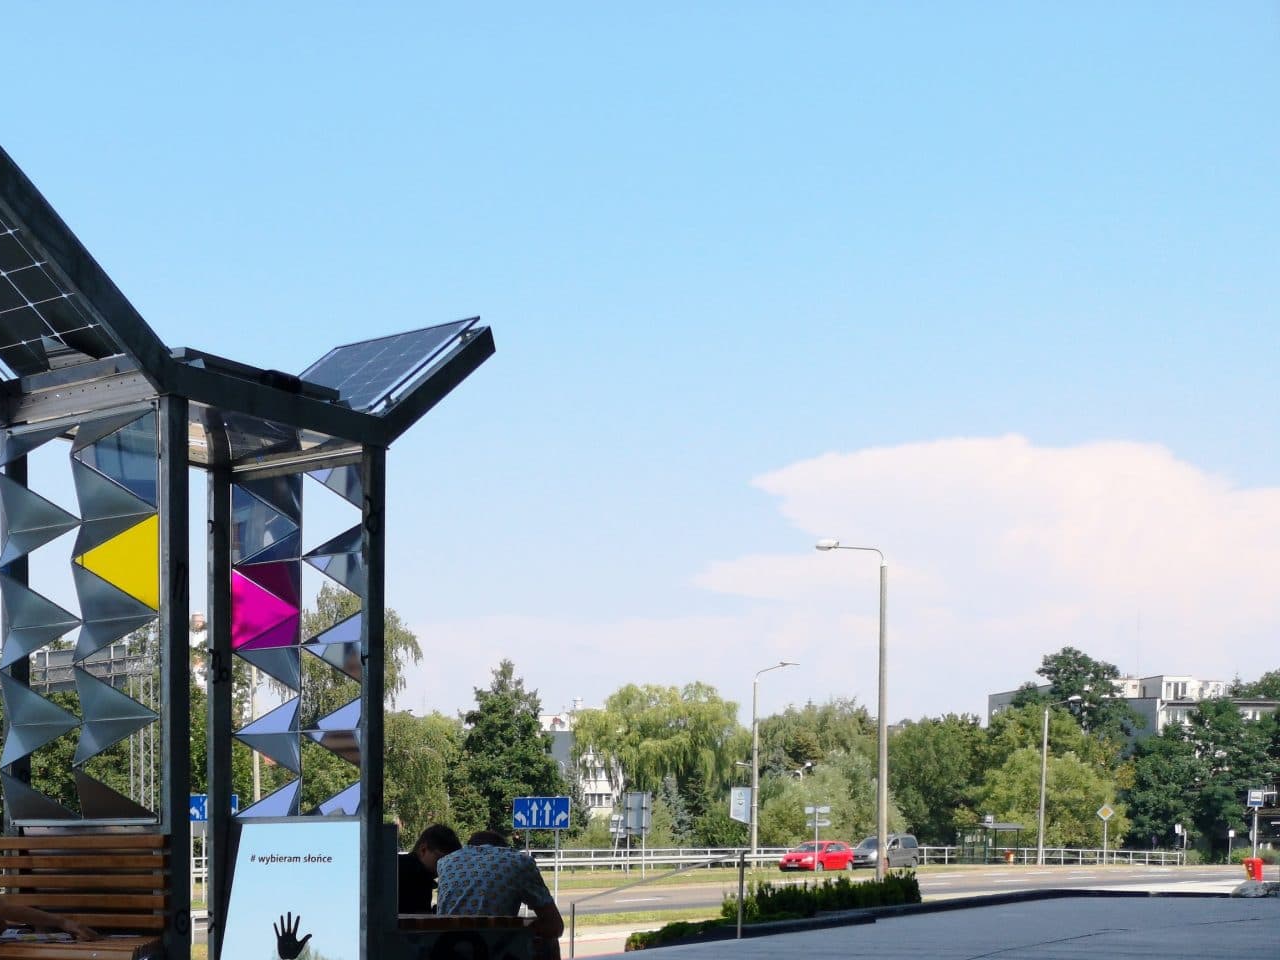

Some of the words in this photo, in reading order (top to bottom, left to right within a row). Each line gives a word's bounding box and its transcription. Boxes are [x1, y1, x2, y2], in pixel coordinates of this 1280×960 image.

[250, 854, 256, 862] #
[258, 854, 301, 865] wybieram
[303, 853, 333, 863] słońce
